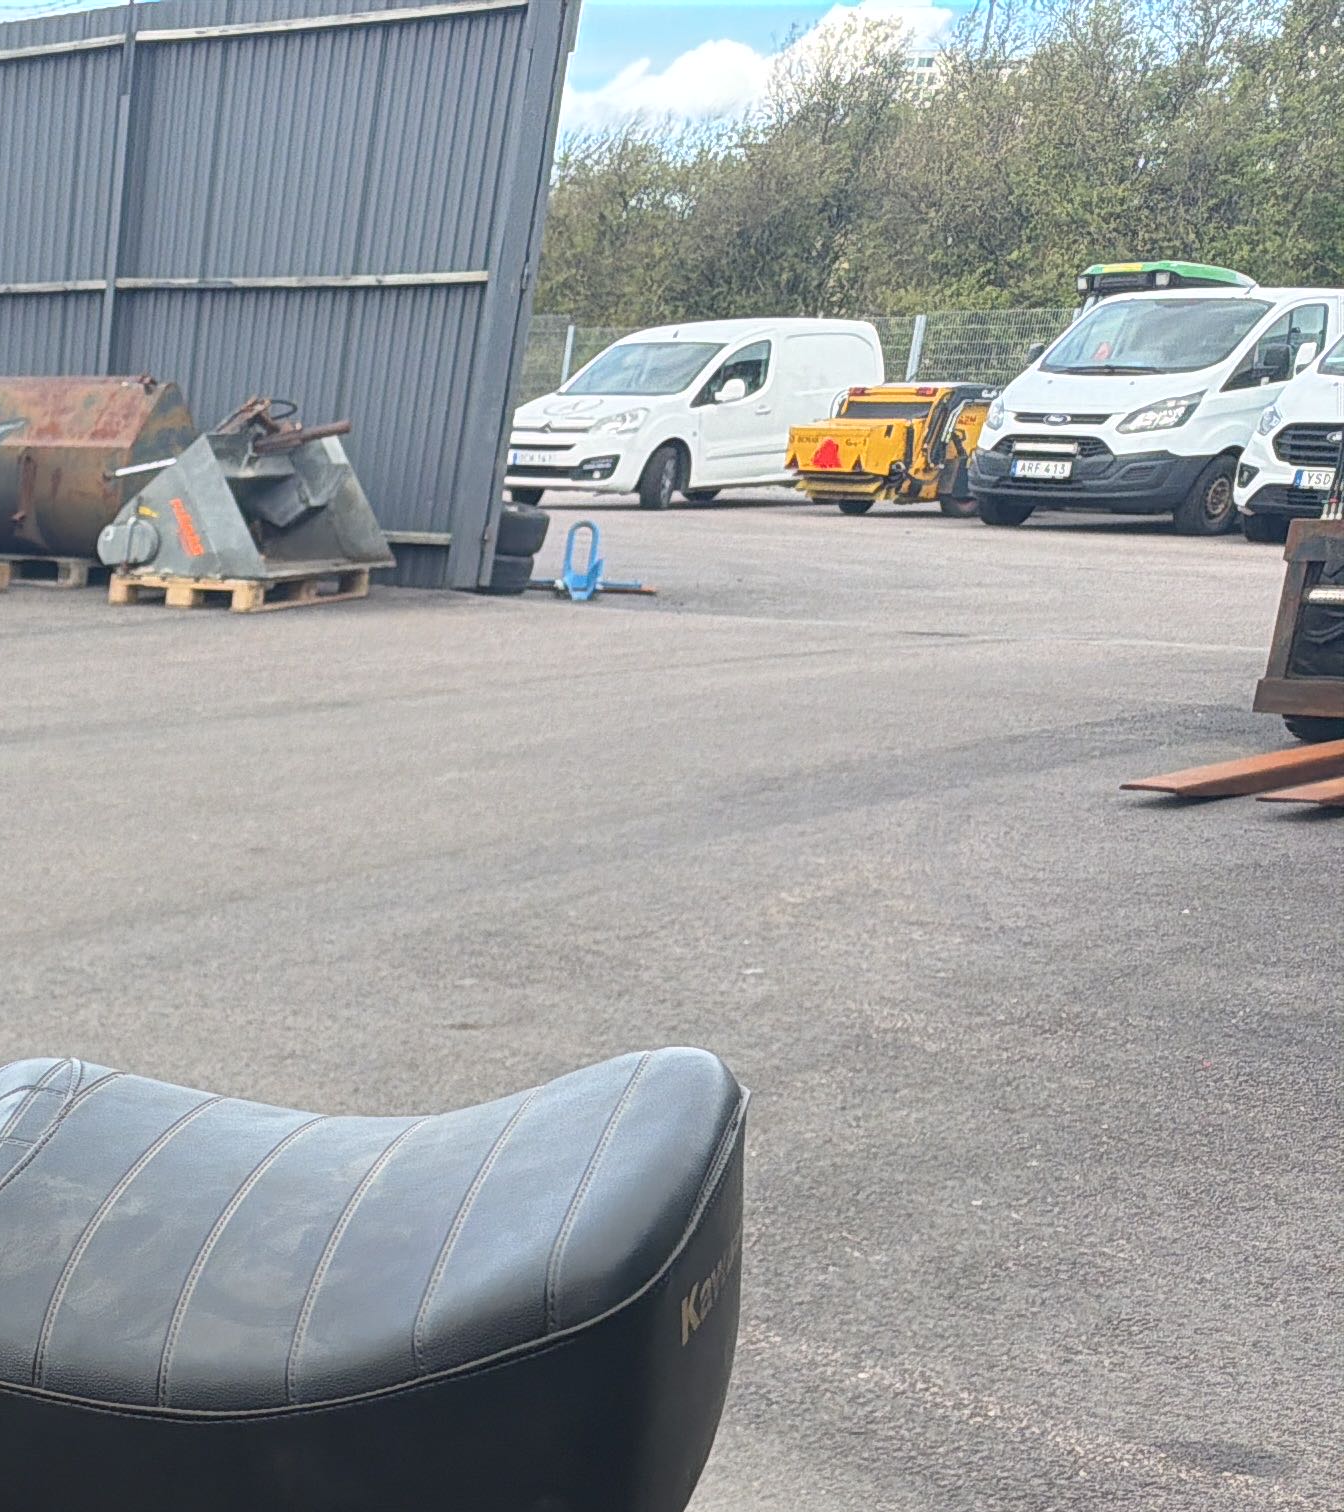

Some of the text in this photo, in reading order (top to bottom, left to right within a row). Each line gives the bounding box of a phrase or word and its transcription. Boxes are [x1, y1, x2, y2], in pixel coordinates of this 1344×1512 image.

[1020, 462, 1065, 475] ARF 413
[1307, 473, 1331, 485] YSD
